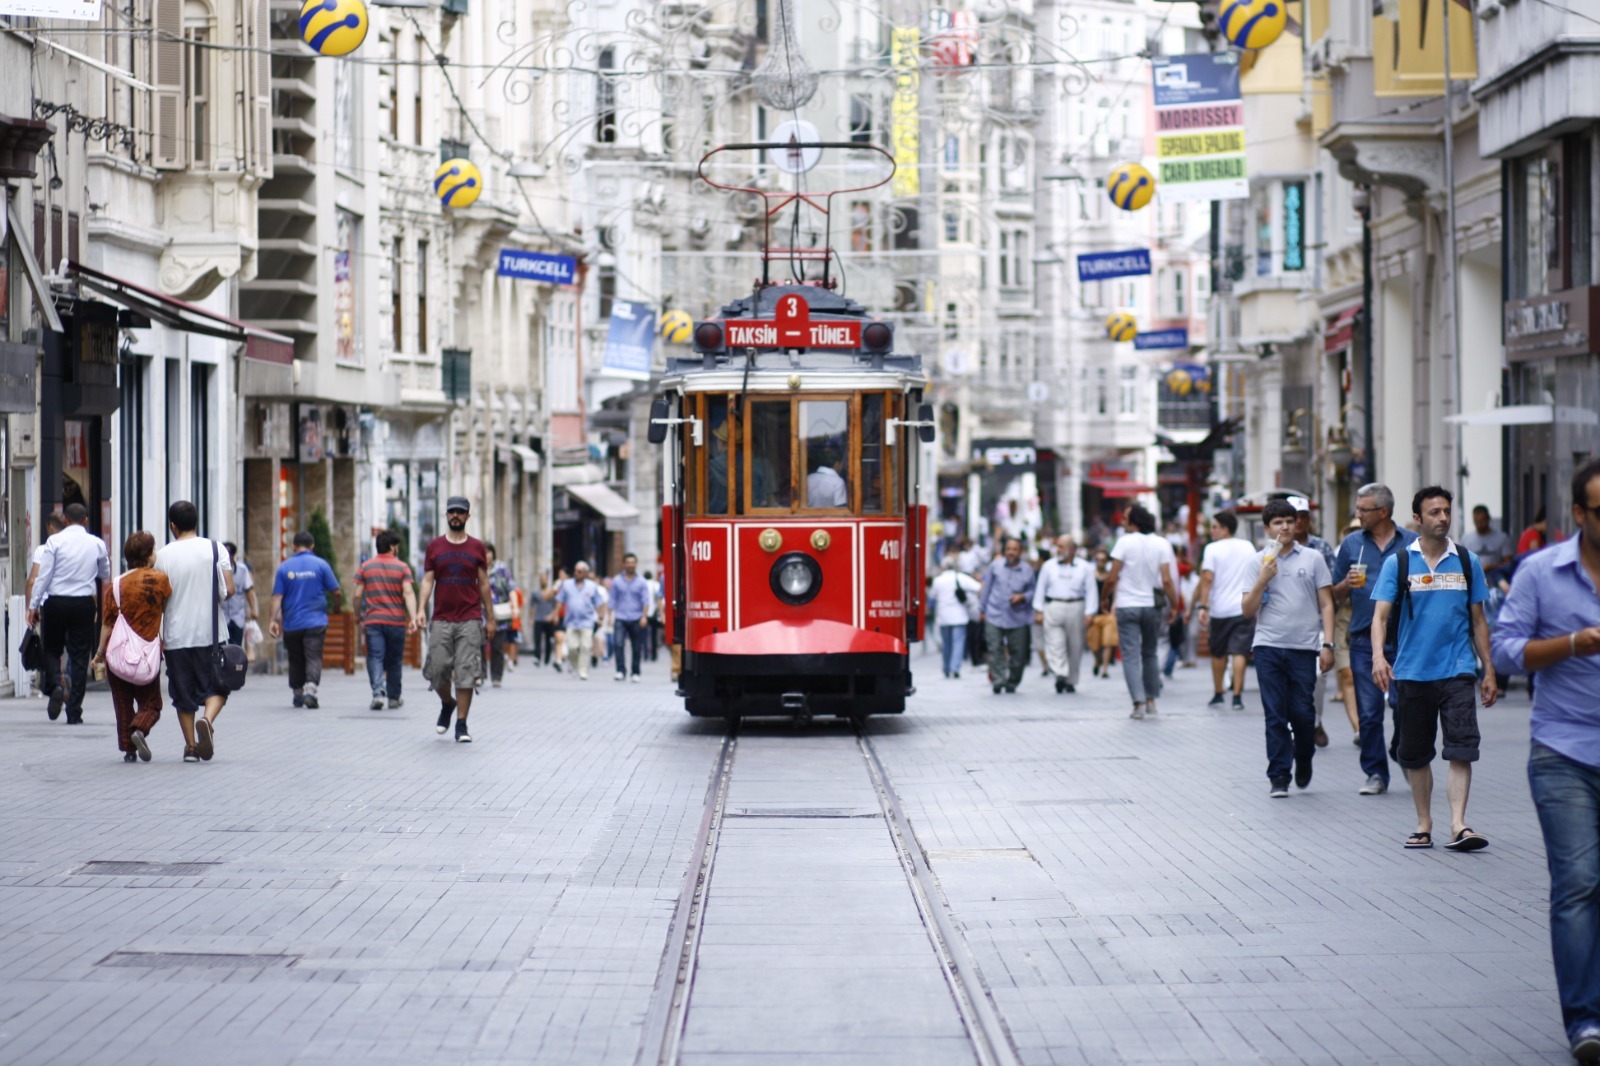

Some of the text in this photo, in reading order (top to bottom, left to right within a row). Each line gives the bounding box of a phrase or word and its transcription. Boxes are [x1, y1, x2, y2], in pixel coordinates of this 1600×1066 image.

[1158, 106, 1238, 130] MORRISSEY
[1163, 158, 1243, 183] CARO EMERALD
[502, 255, 570, 278] TURKCELL
[1080, 255, 1149, 275] TURKCELL
[787, 297, 797, 318] 3
[729, 324, 777, 344] TAKSİM
[809, 324, 855, 345] TÜNEL
[691, 540, 712, 561] 410
[879, 539, 900, 560] 410
